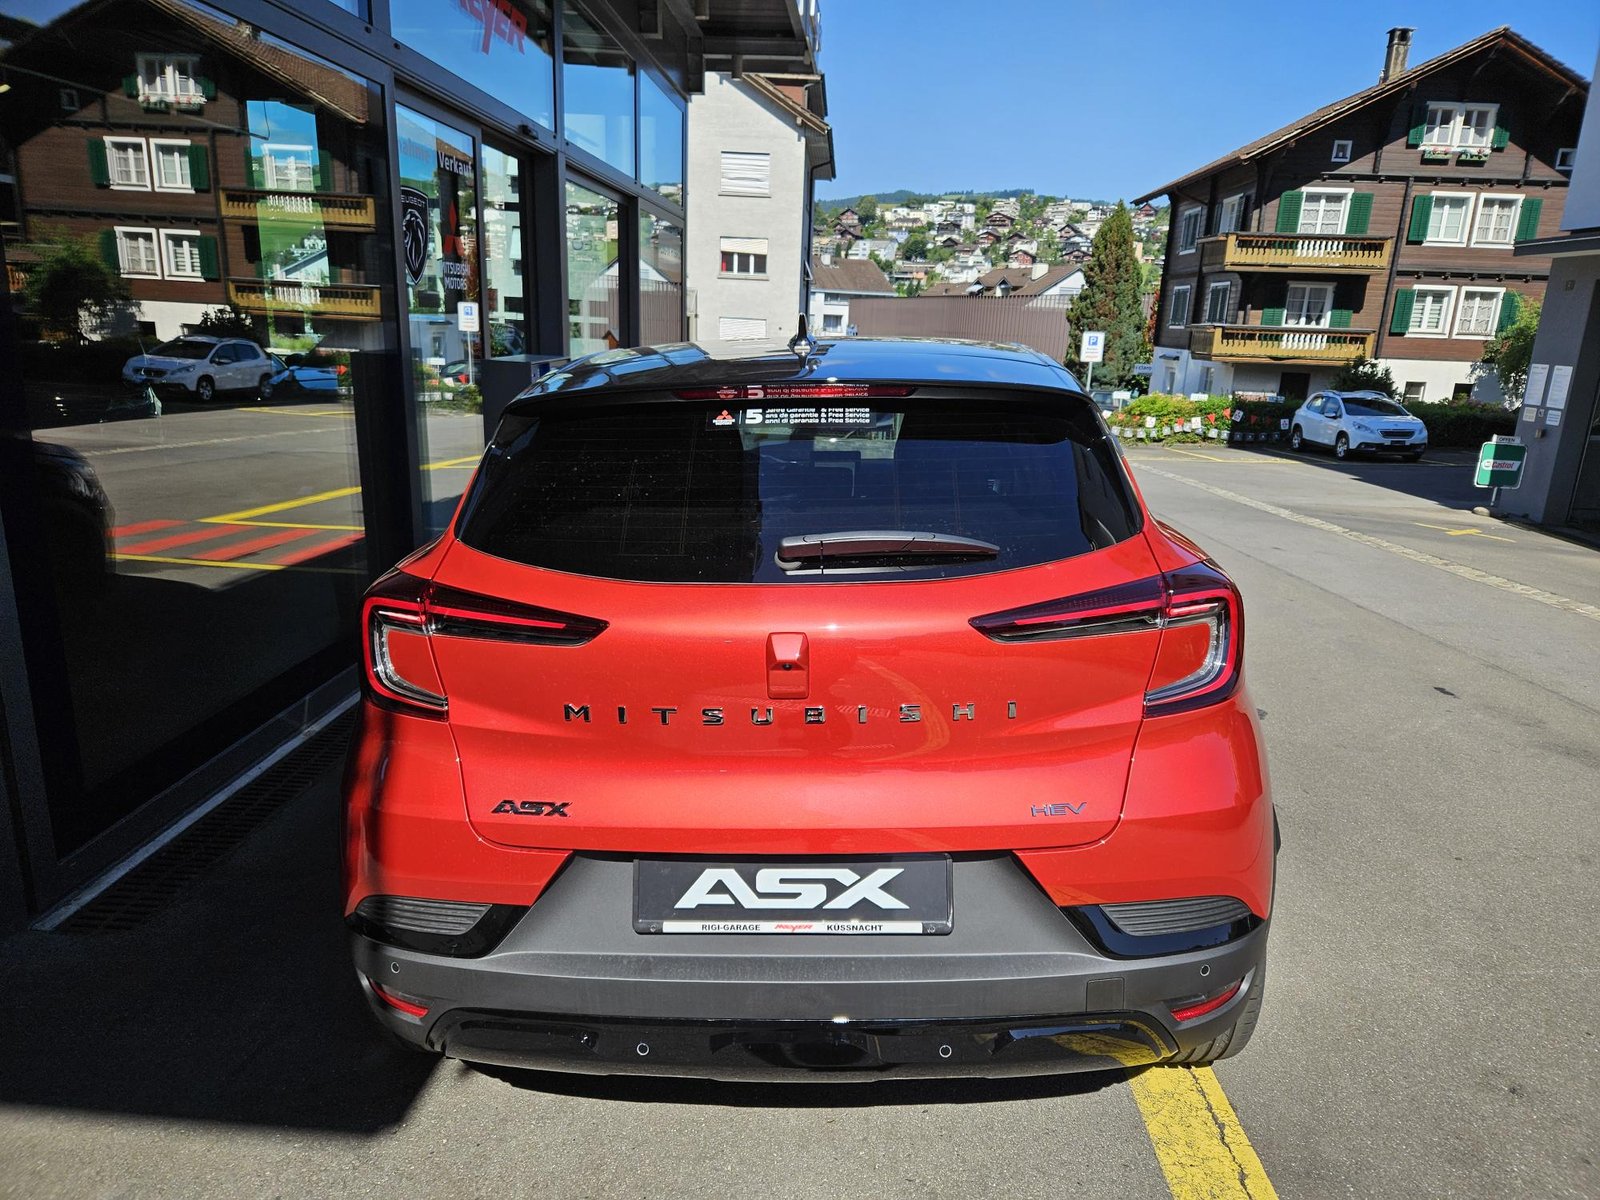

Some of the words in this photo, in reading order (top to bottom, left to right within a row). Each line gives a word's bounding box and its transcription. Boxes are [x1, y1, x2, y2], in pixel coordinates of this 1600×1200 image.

[459, 0, 527, 55] EYER
[438, 151, 472, 177] Verkauf
[444, 276, 468, 291] MOTORS
[745, 409, 763, 424] 5
[1491, 461, 1514, 469] Castrol
[563, 700, 1018, 726] MITSUBISHI
[491, 799, 573, 817] ASX
[1031, 801, 1088, 817] HEV
[673, 868, 910, 909] ASX
[701, 923, 761, 931] RIGI-GARAGE
[826, 922, 884, 931] KÜSSNACHT
